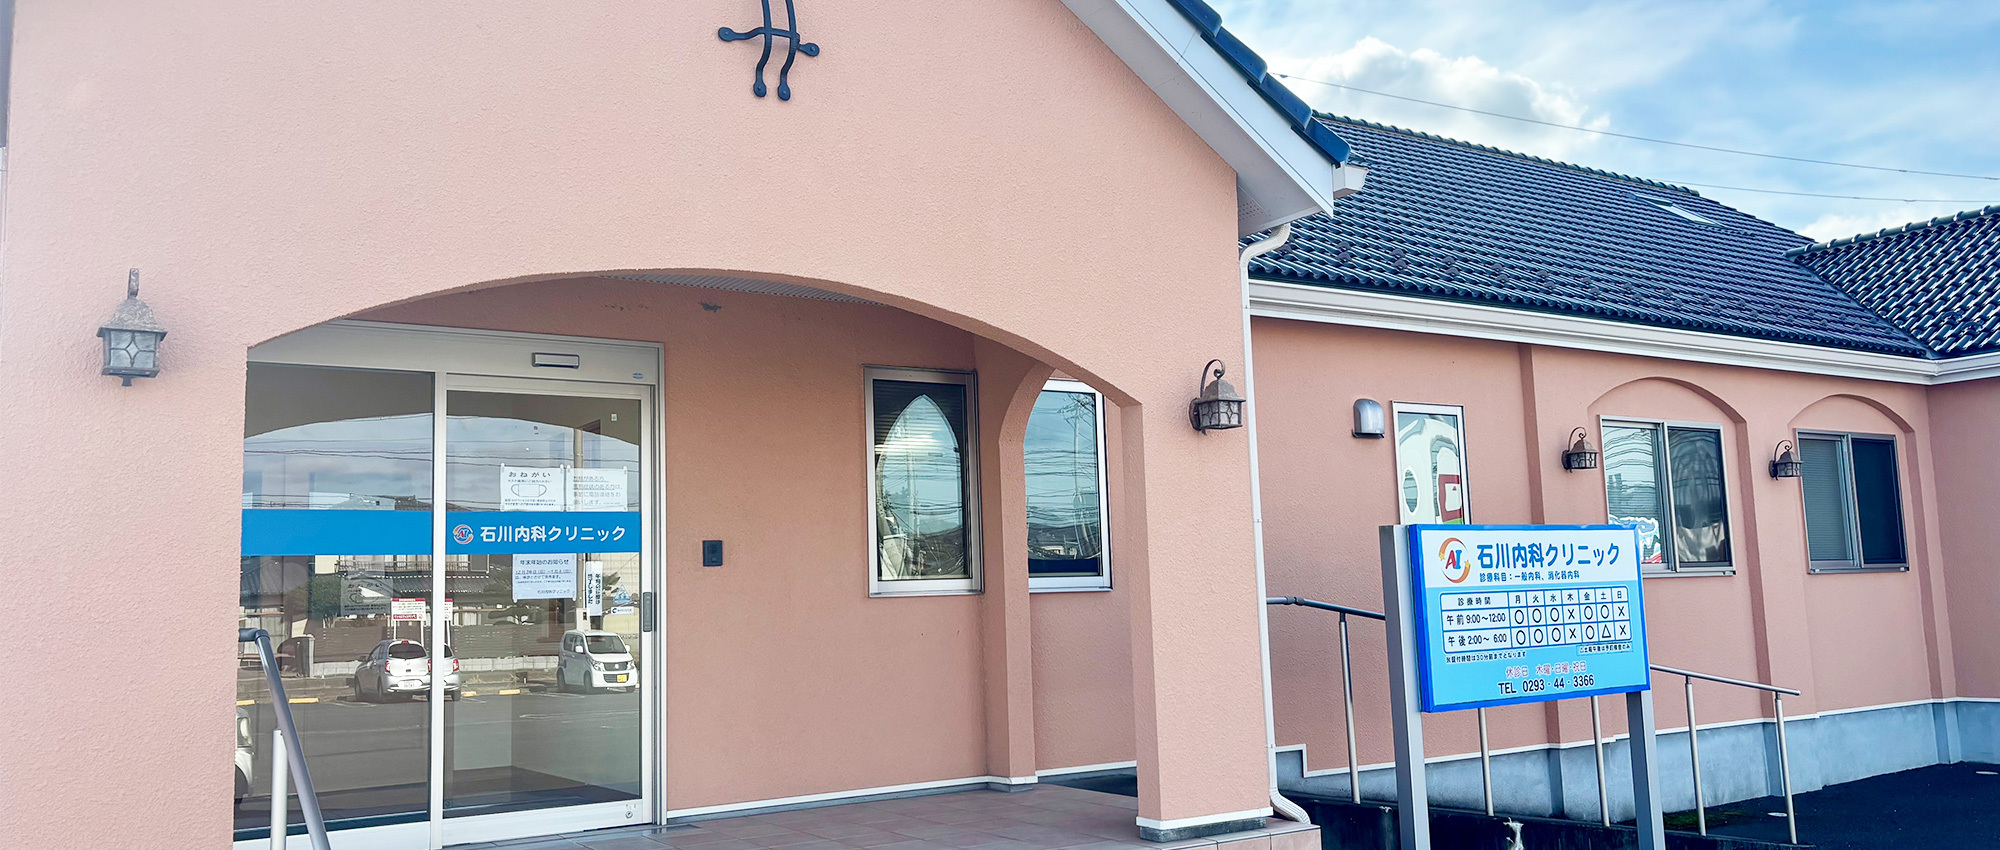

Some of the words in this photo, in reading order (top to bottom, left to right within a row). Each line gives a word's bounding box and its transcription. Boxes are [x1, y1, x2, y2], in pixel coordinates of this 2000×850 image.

[480, 525, 626, 543] 石川内科クリニック
[1476, 542, 1620, 570] 石川内科クリニック
[1457, 597, 1491, 606] 診療時間
[1514, 594, 1521, 604] 月
[1532, 594, 1540, 603] 火
[1549, 593, 1557, 603] 水
[1567, 592, 1574, 602] 木
[1584, 591, 1591, 601] 金
[1600, 591, 1607, 600] 土
[1617, 591, 1623, 599] 日
[1446, 613, 1465, 626] 午前
[1448, 634, 1466, 646] 午後
[1506, 666, 1529, 679] 休診日
[1498, 682, 1516, 695] TEL
